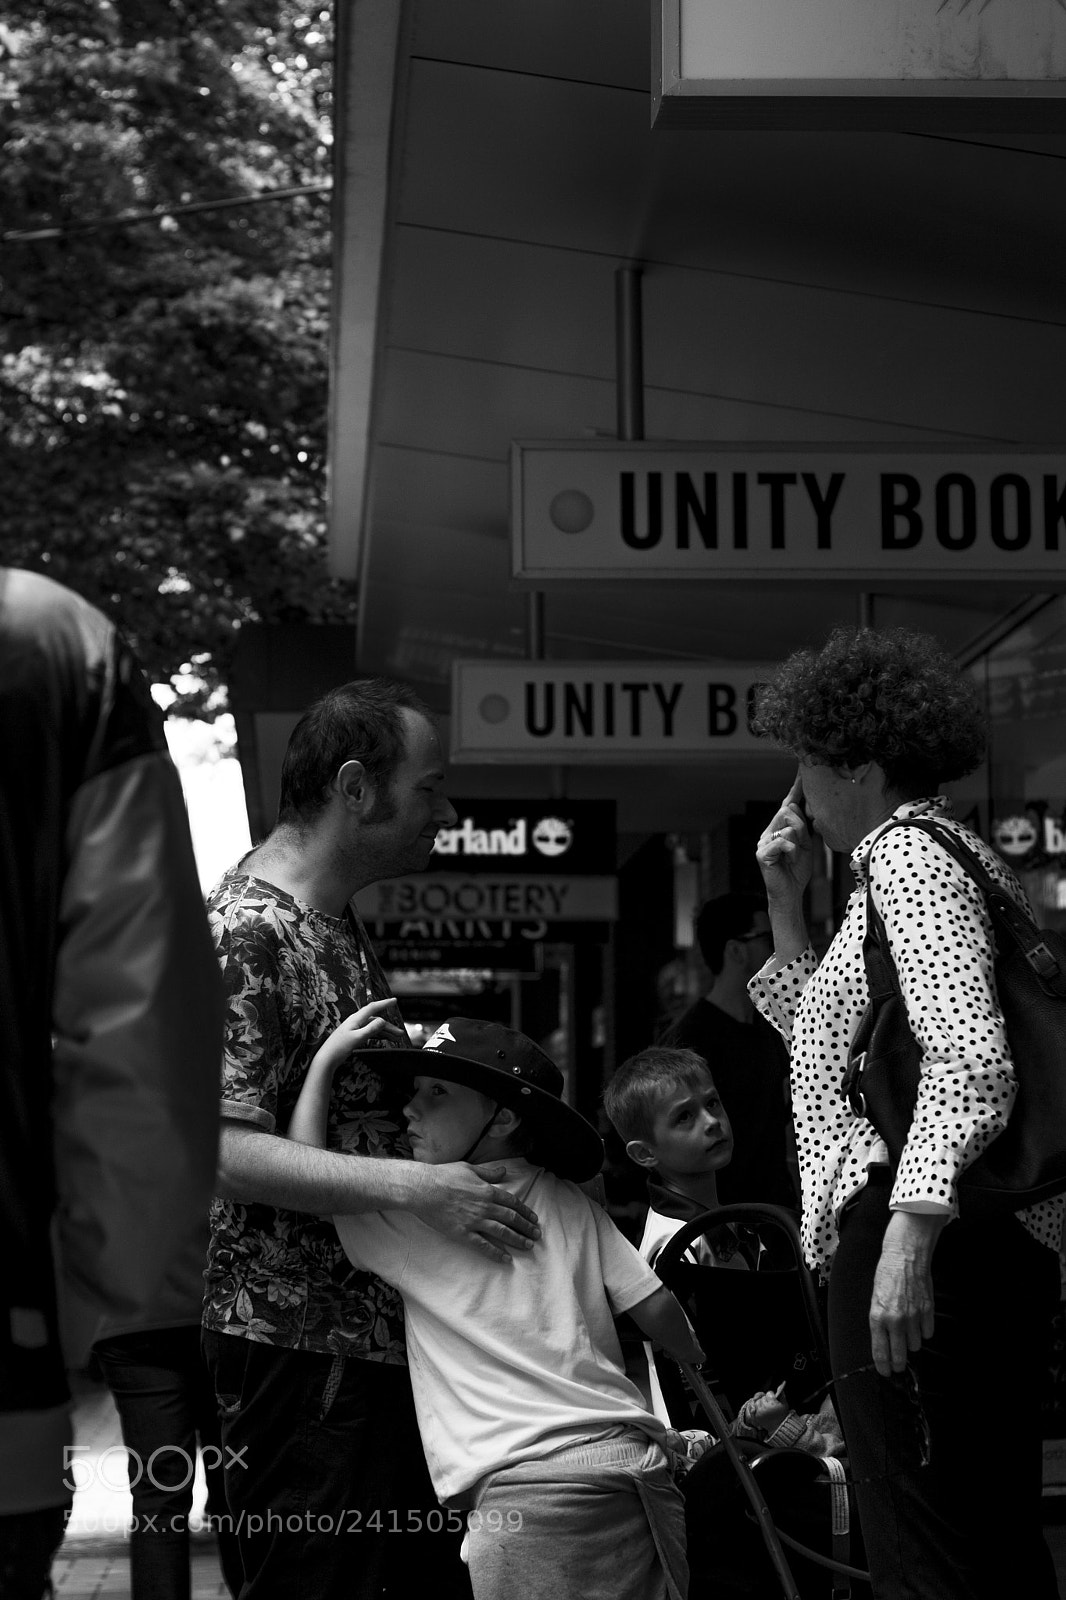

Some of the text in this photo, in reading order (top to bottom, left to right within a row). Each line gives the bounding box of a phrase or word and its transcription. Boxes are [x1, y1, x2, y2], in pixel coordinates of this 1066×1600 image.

[621, 473, 845, 549] UNITY
[526, 684, 683, 736] UNITY
[400, 884, 568, 913] BOOTERY
